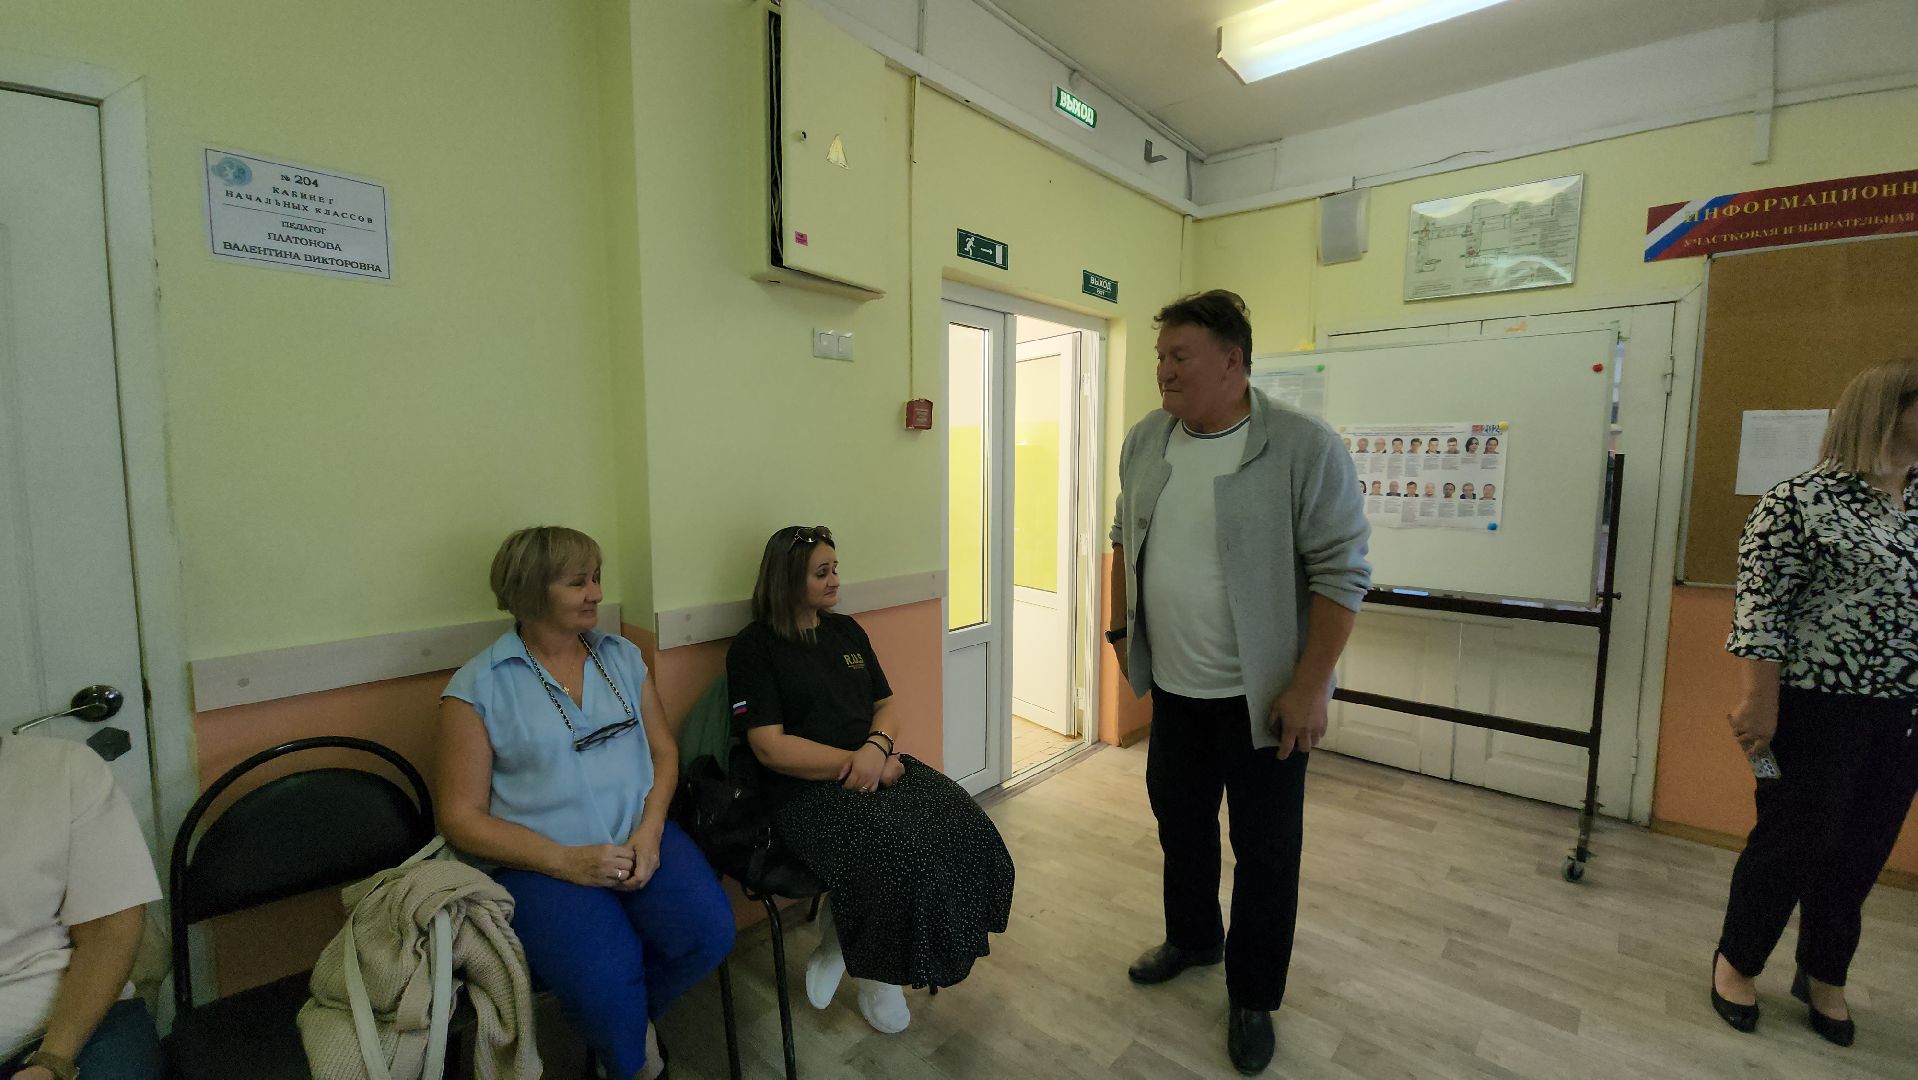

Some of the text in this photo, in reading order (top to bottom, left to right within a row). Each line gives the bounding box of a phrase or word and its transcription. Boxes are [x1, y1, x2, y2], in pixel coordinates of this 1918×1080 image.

[1060, 90, 1094, 126] ВЫХОД
[280, 174, 319, 188] № 204
[225, 190, 373, 224] НАЧАЛЬНЫХ КЛАССОВ
[281, 220, 327, 235] ПЕДАГОГ
[1684, 212, 1914, 248] УЧАСТКОВАЯ ИЗБИРАТЕЛЬНАЯ
[267, 232, 342, 252] ПЛАТОНОВА
[223, 241, 382, 273] ВАЛЕНТИНА ВИКТОРОВНА
[1090, 276, 1112, 291] ВЫХОД
